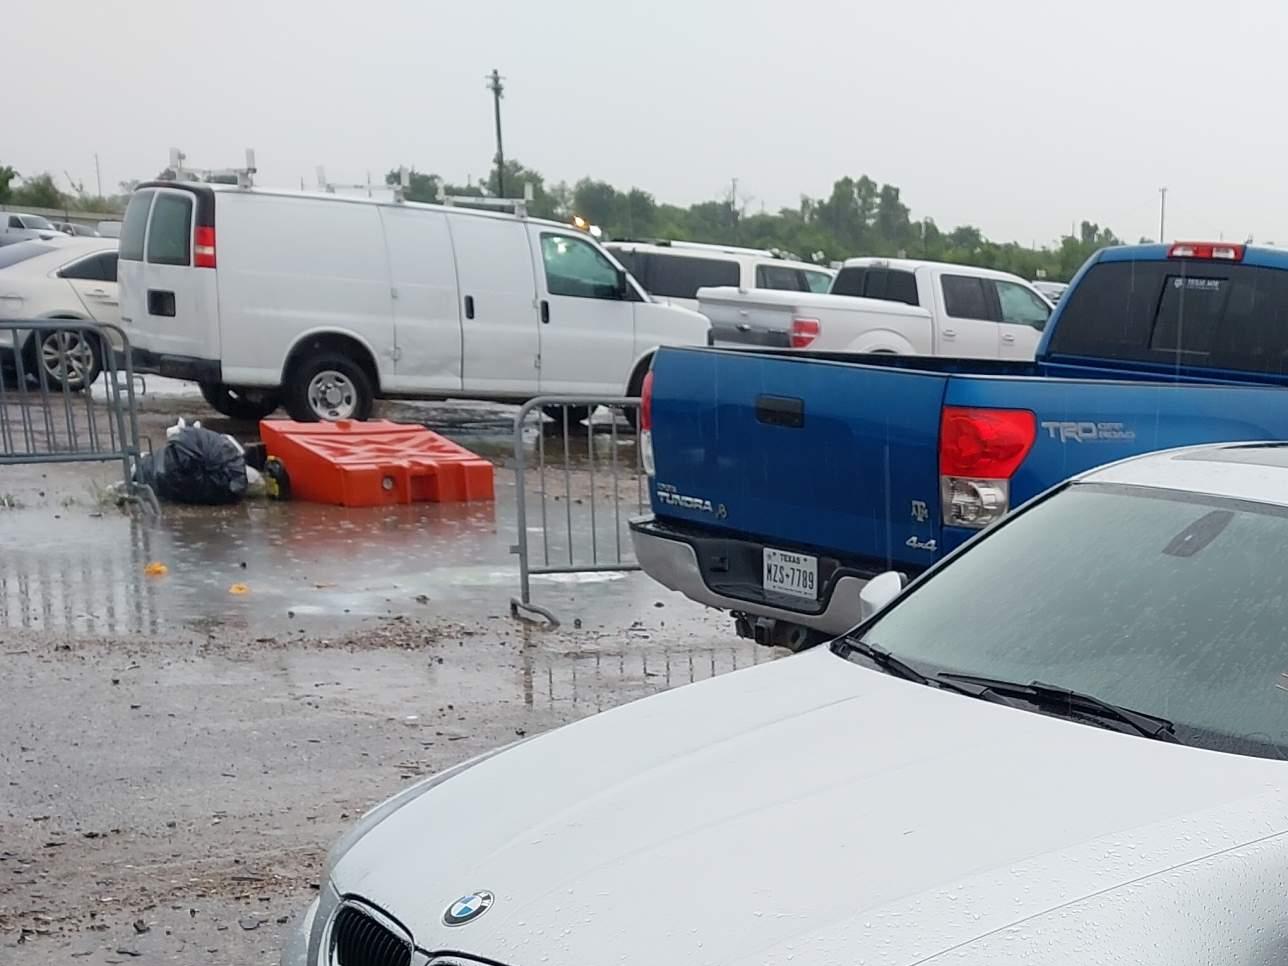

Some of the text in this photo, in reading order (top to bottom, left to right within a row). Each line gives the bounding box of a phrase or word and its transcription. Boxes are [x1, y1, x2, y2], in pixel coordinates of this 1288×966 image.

[1040, 421, 1097, 443] TRD
[656, 490, 713, 513] TUNDRA
[779, 553, 801, 565] TEXAS
